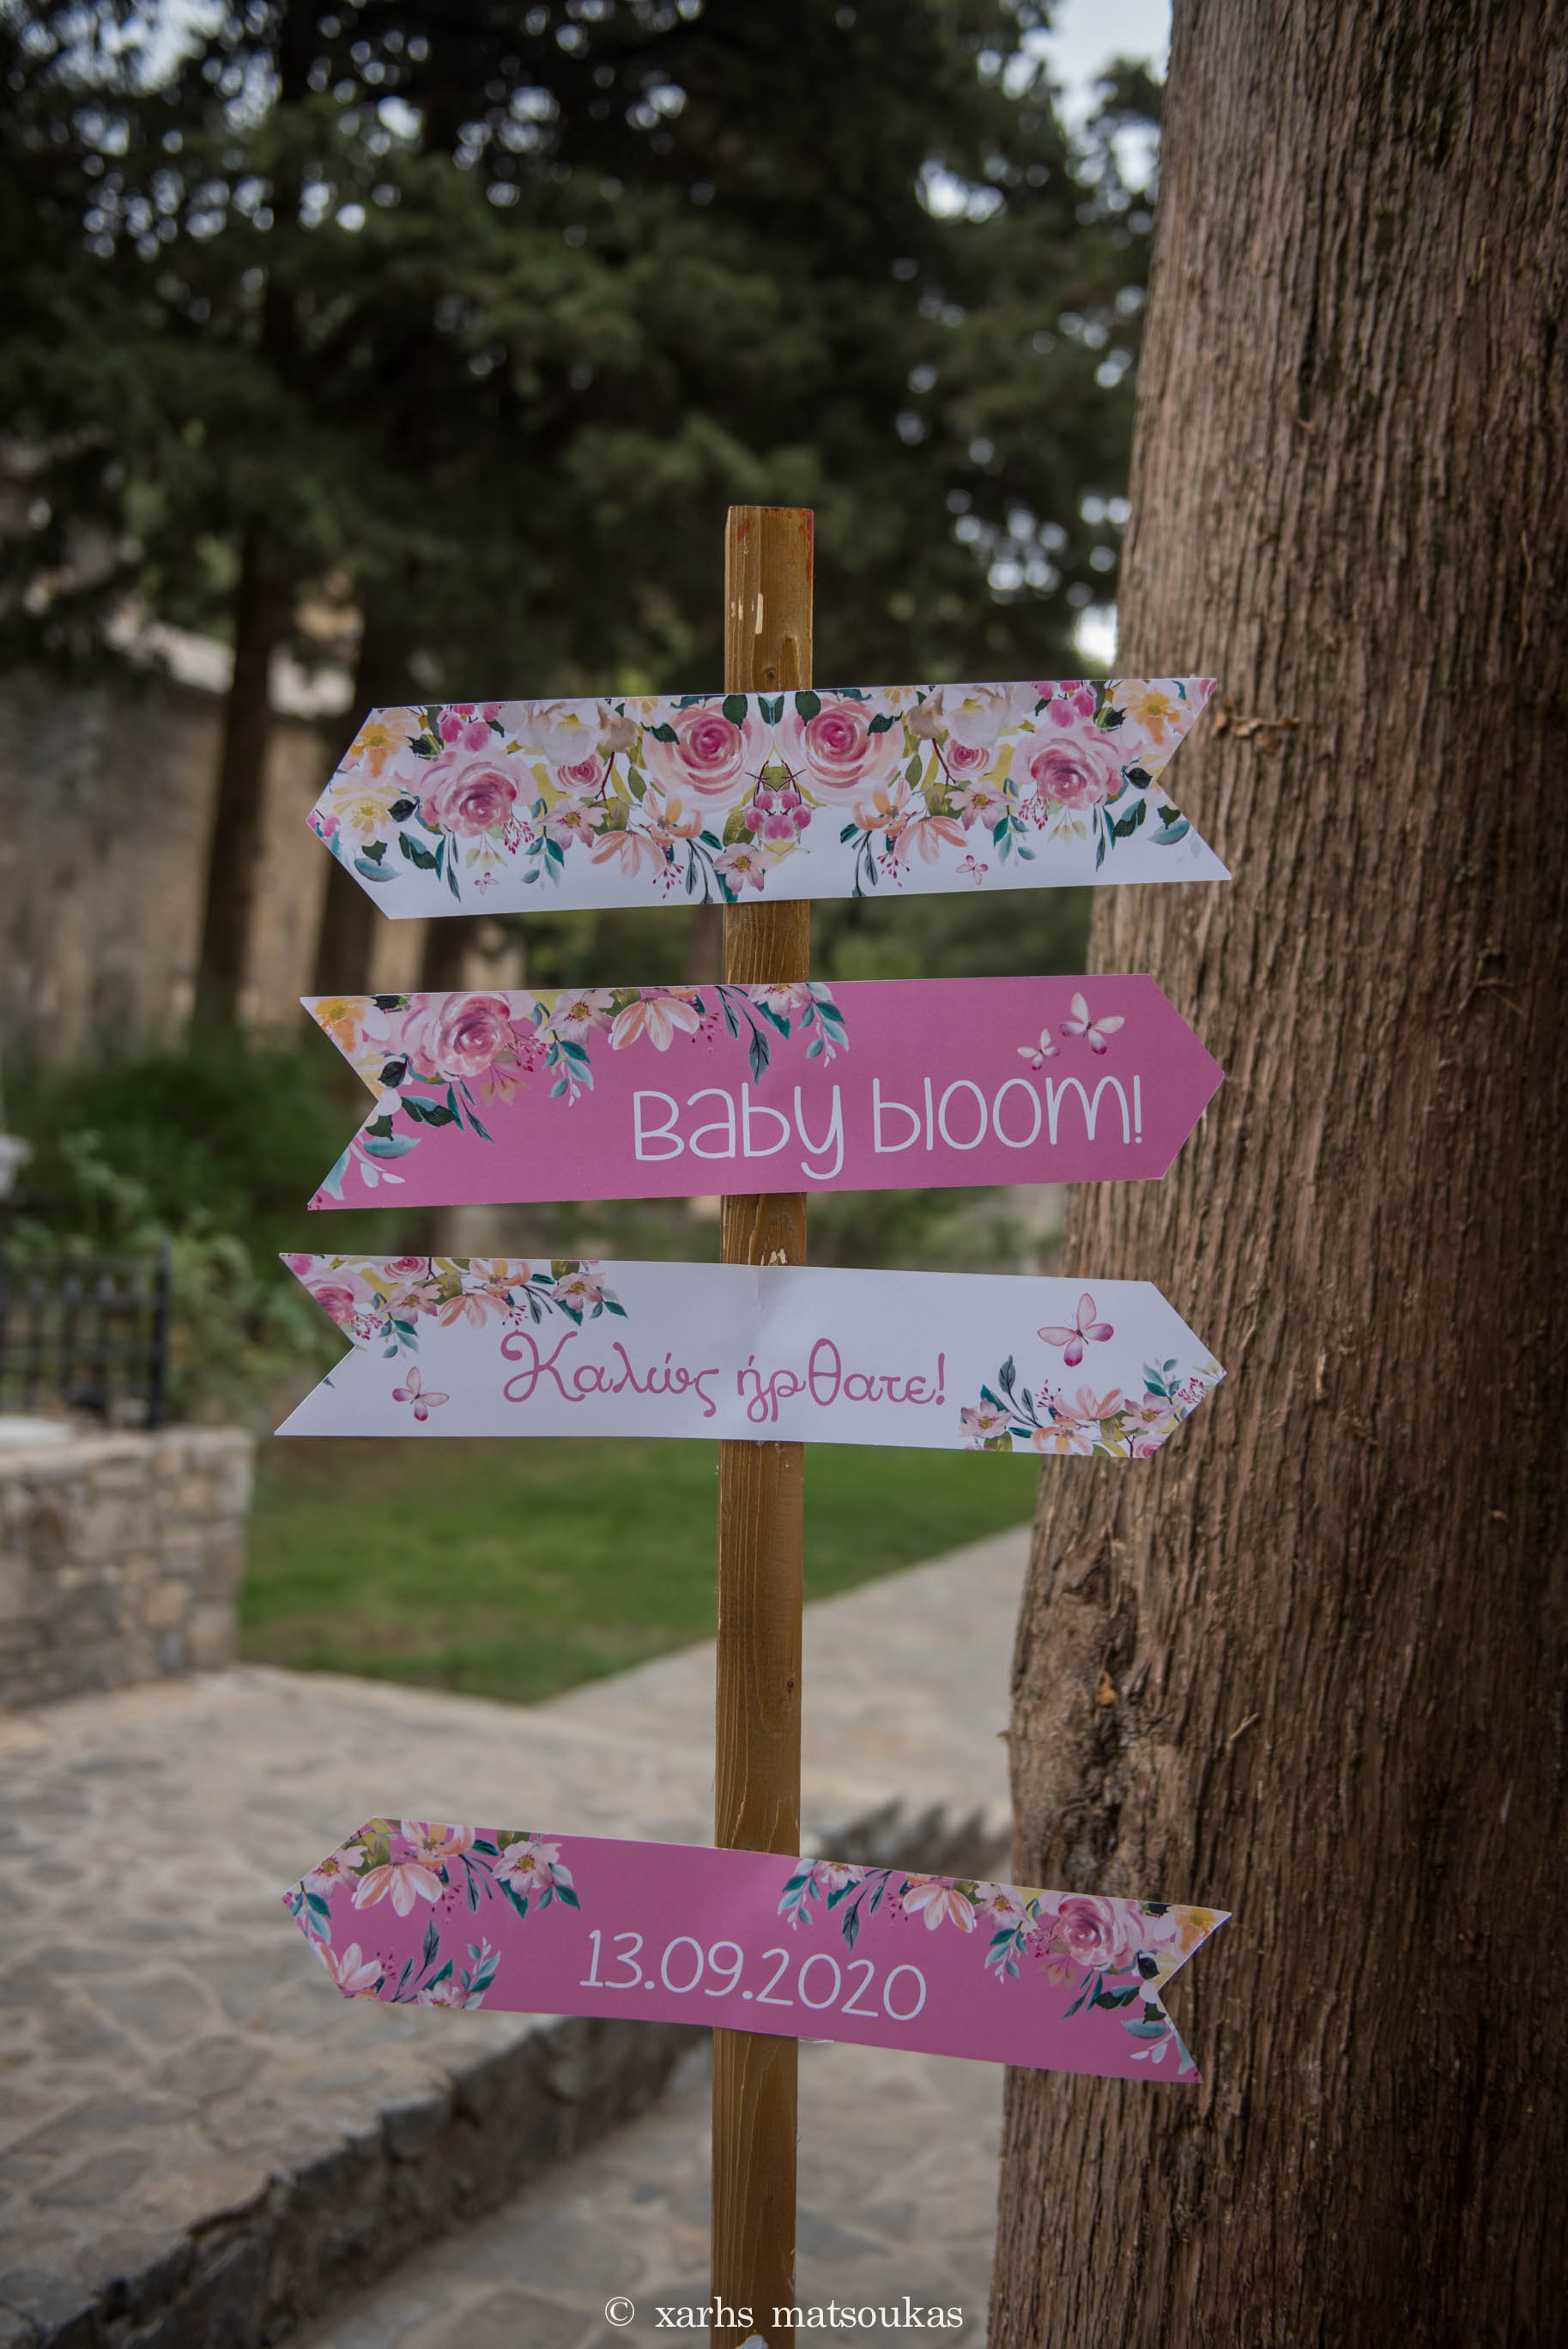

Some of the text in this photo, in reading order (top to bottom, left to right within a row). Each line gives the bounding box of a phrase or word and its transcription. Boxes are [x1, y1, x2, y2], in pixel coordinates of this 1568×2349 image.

[633, 1075, 1142, 1180] Baby bloom!
[500, 1329, 946, 1423] Καλώς ήρθατε!
[579, 1929, 927, 2021] 13.09.2020
